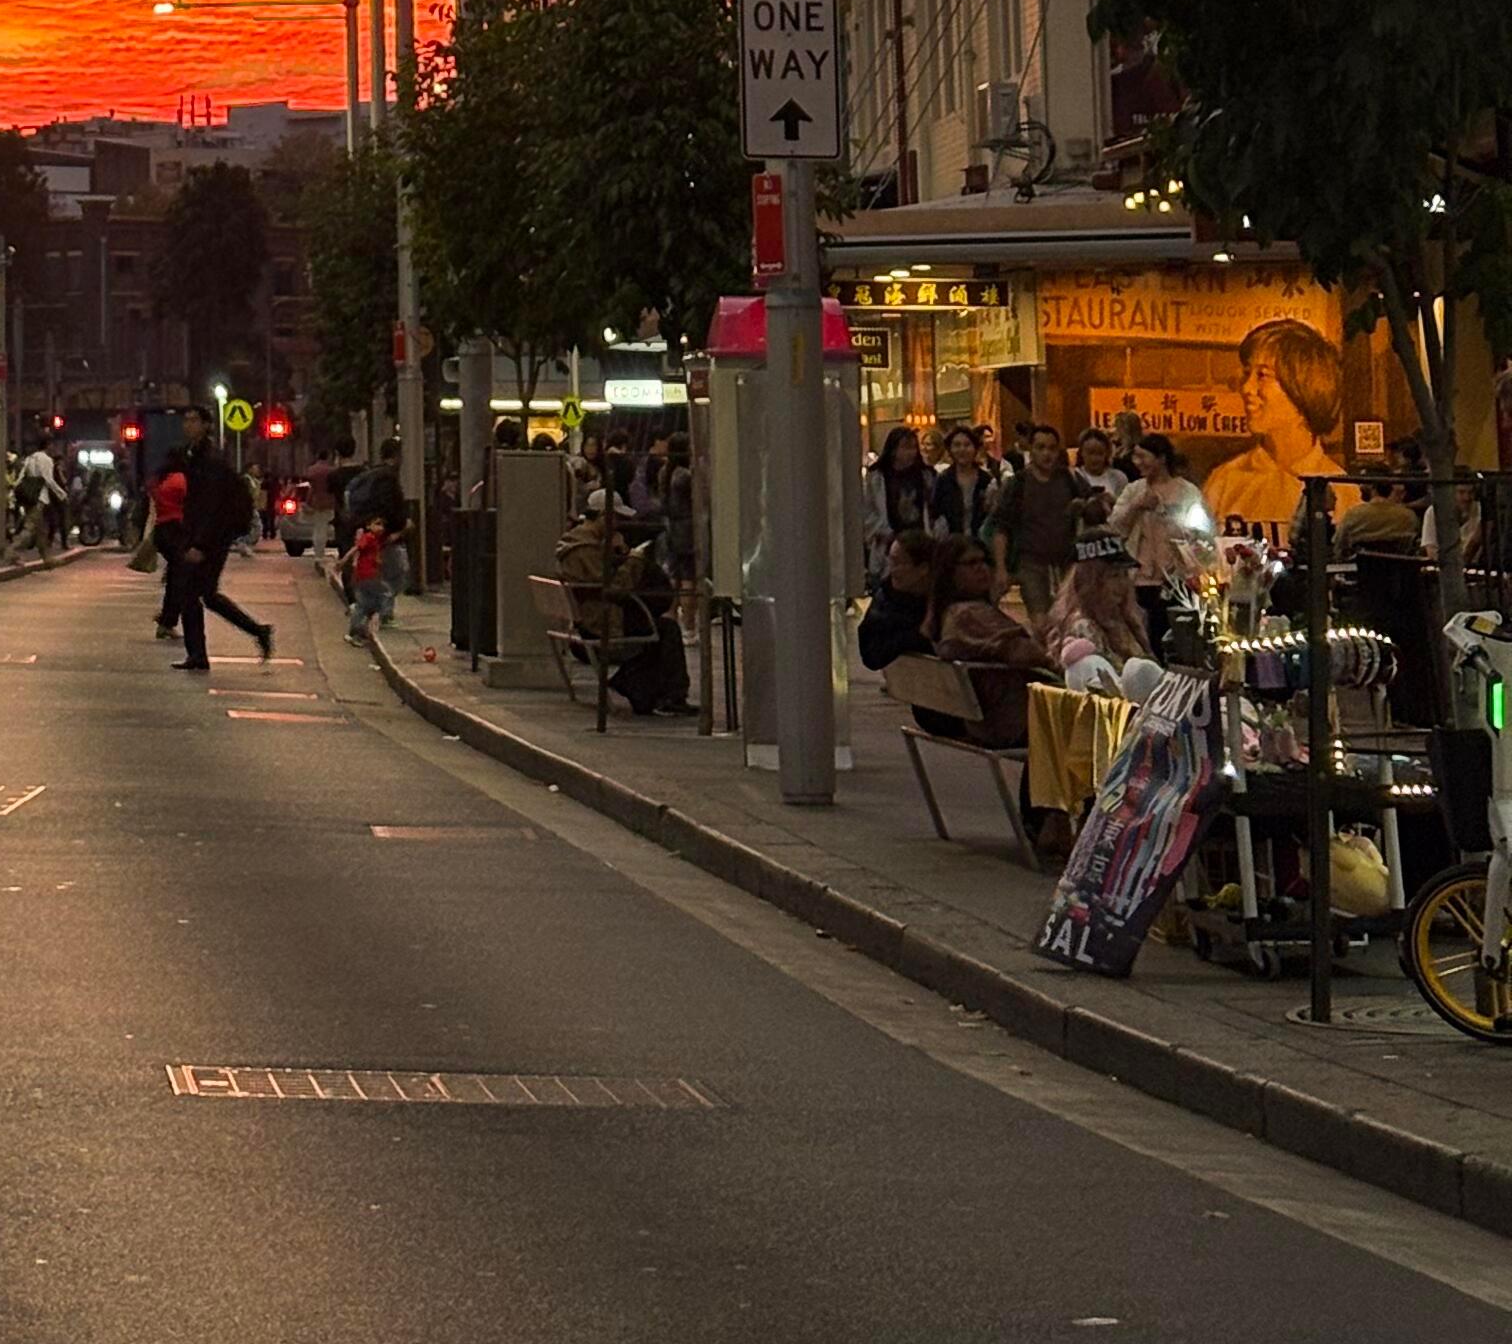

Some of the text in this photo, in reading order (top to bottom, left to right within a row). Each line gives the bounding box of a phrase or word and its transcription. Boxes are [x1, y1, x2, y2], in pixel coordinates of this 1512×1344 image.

[753, 0, 825, 32] ONE
[749, 49, 830, 81] WAY
[1141, 411, 1173, 430] SUN
[1213, 412, 1248, 433] CAFE
